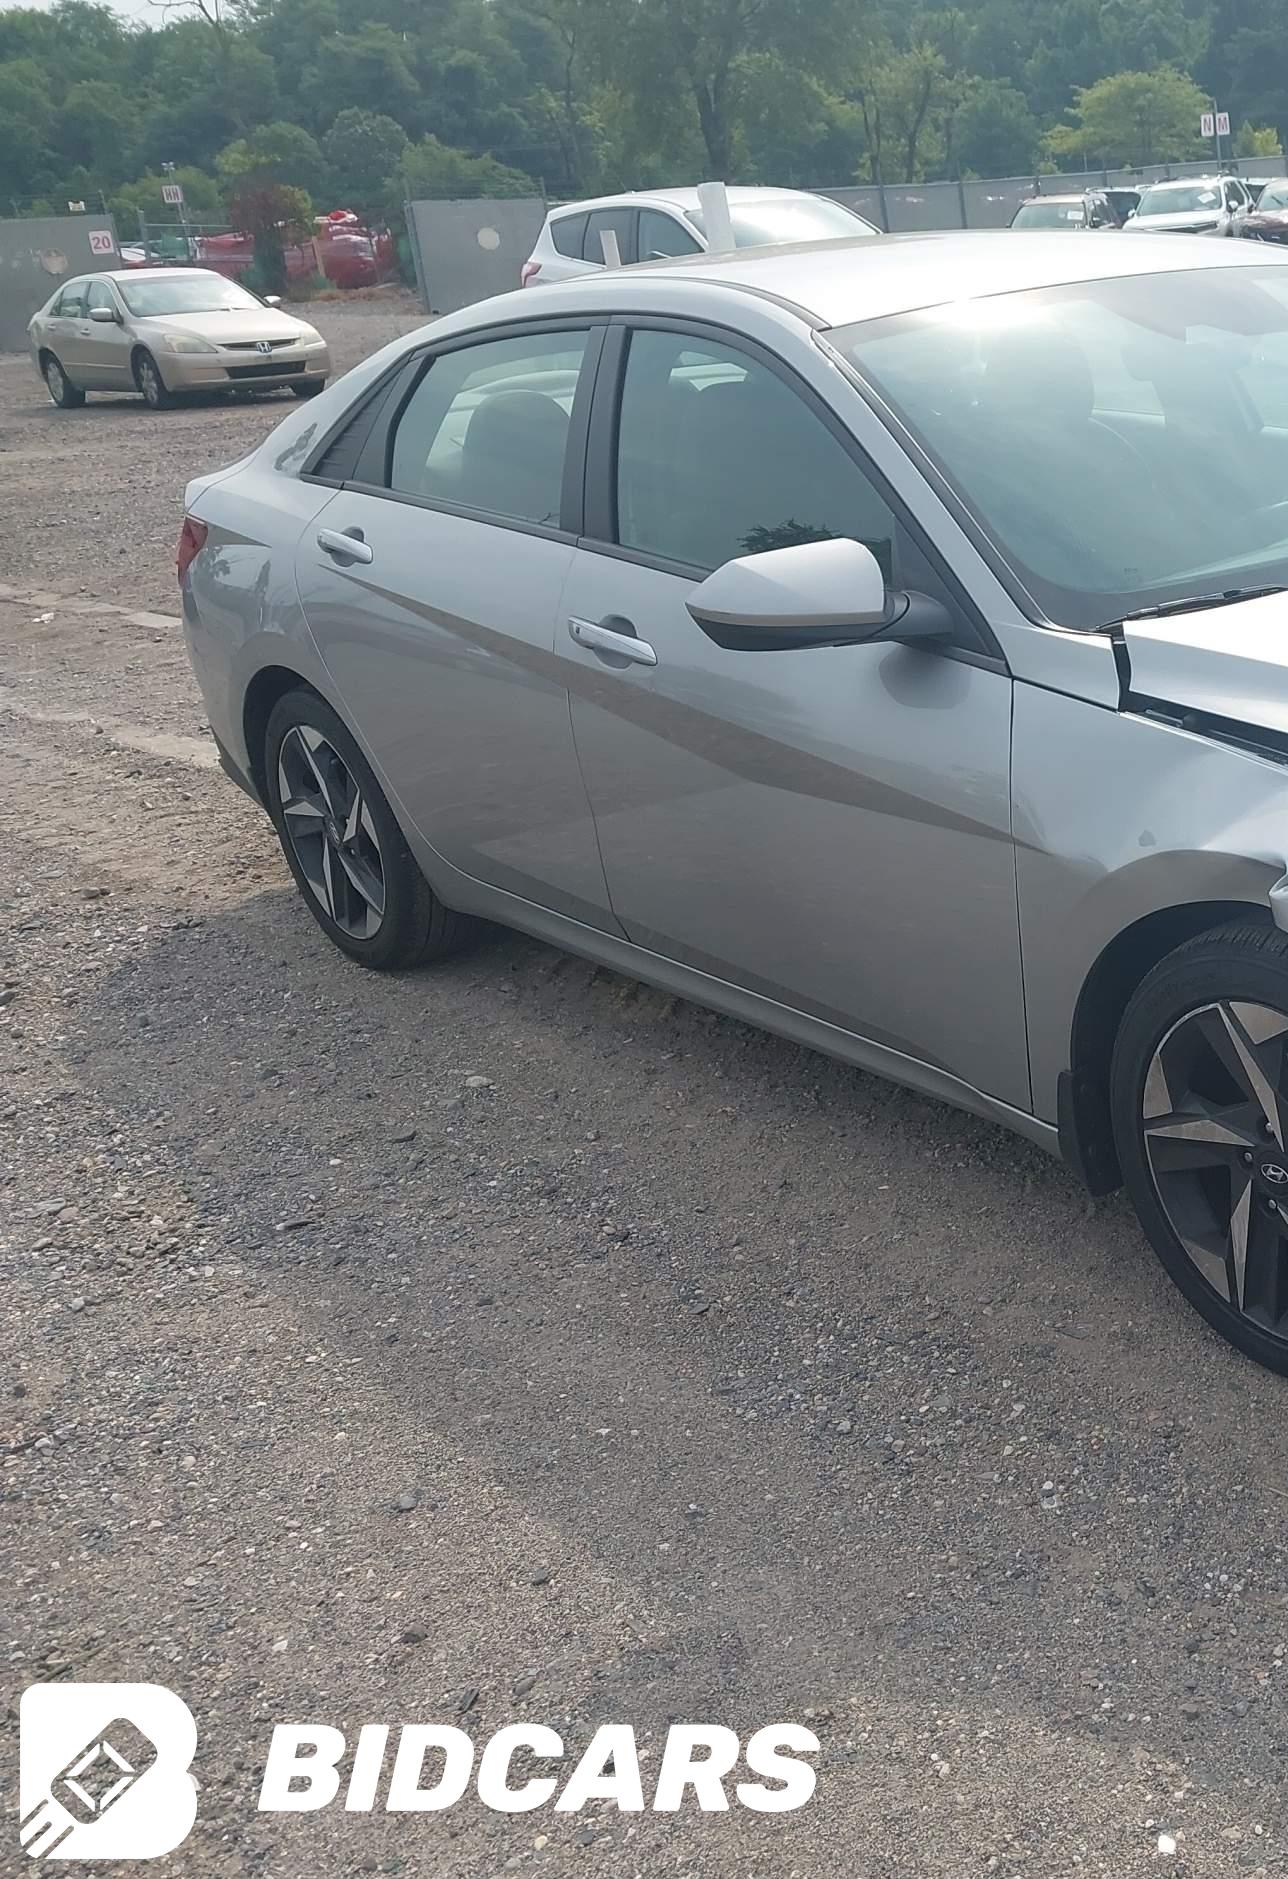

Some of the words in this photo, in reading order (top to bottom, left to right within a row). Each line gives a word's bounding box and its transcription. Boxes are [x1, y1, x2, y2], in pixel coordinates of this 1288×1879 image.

[1203, 117, 1212, 132] N
[1218, 116, 1228, 131] M
[92, 236, 111, 250] 20
